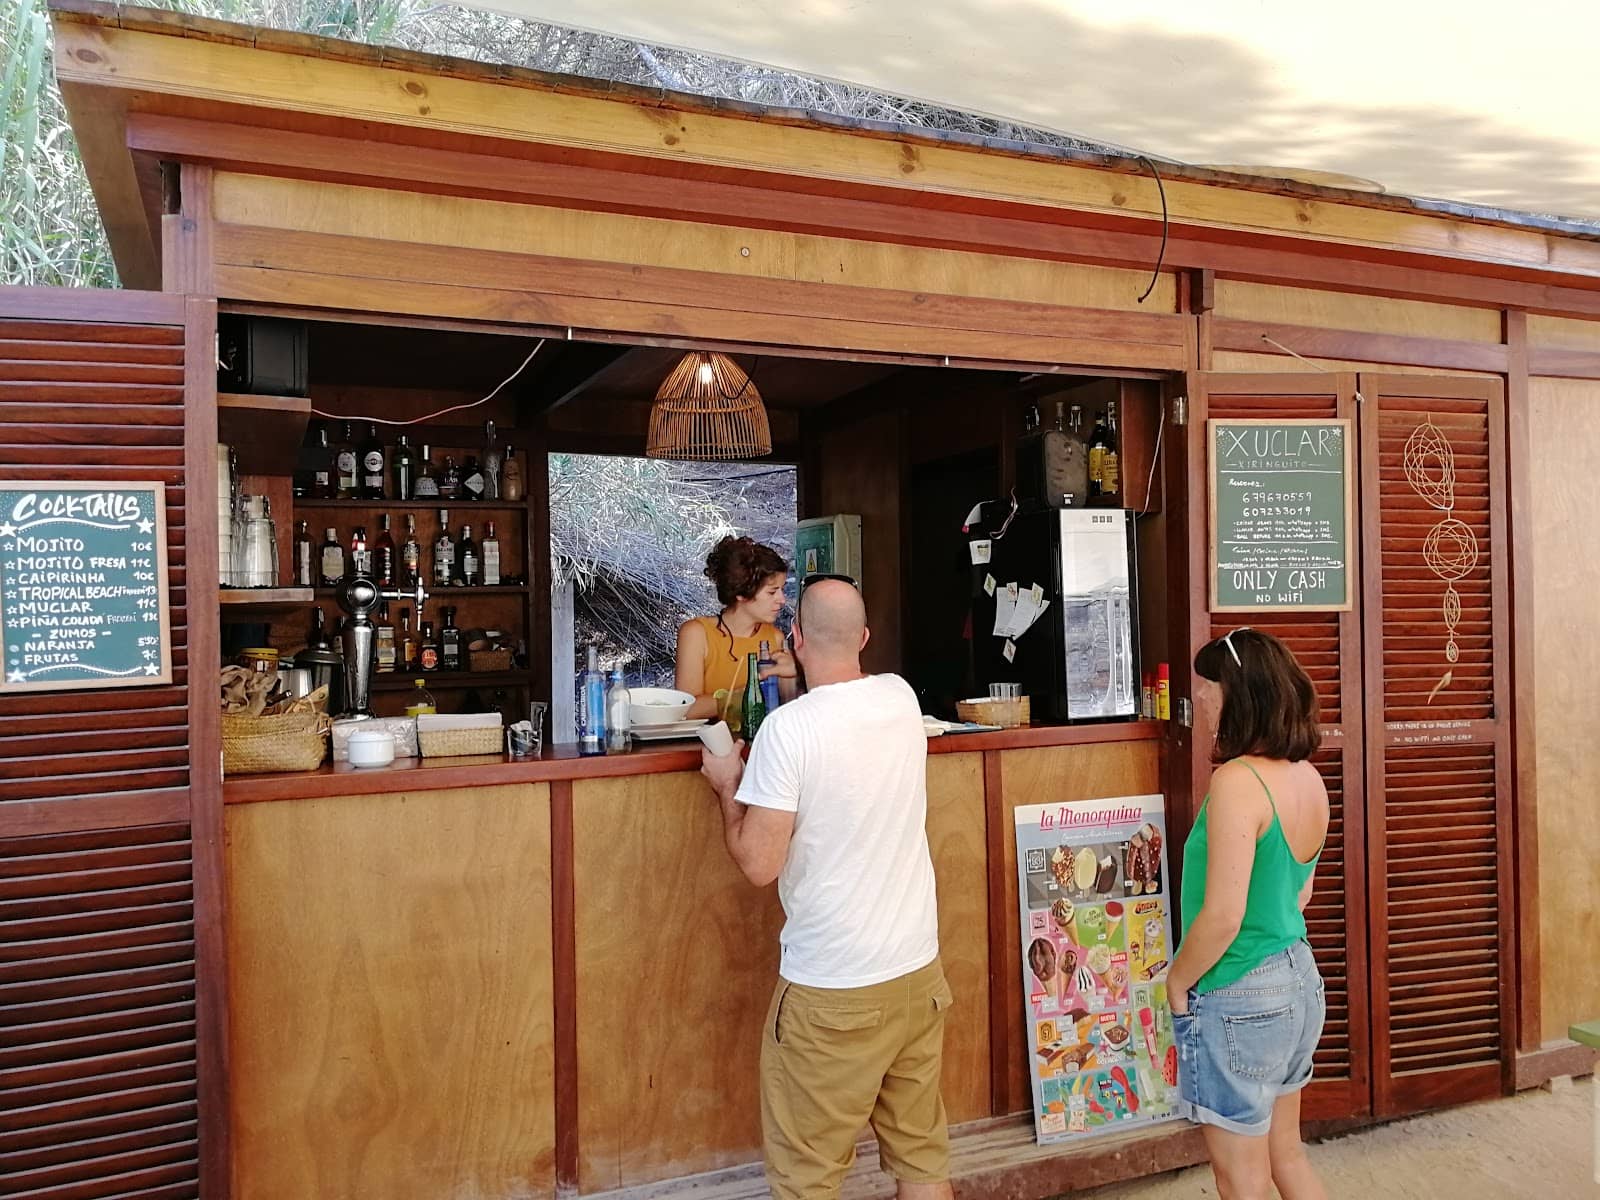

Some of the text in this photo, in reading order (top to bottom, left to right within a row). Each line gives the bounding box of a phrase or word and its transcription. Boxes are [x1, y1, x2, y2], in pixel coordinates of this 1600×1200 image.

[1226, 428, 1333, 457] XUCLAR
[90, 557, 127, 570] FRESA
[1233, 570, 1326, 590] ONLY CASH
[18, 586, 86, 601] TROPICAL
[86, 585, 122, 600] BEACH
[1256, 593, 1271, 604] NO
[61, 615, 104, 626] COLADA
[49, 627, 97, 640] ZUMOS
[24, 640, 95, 653] NARANJA
[24, 653, 79, 666] FRUTAS
[1040, 804, 1142, 829] la Menorquina
